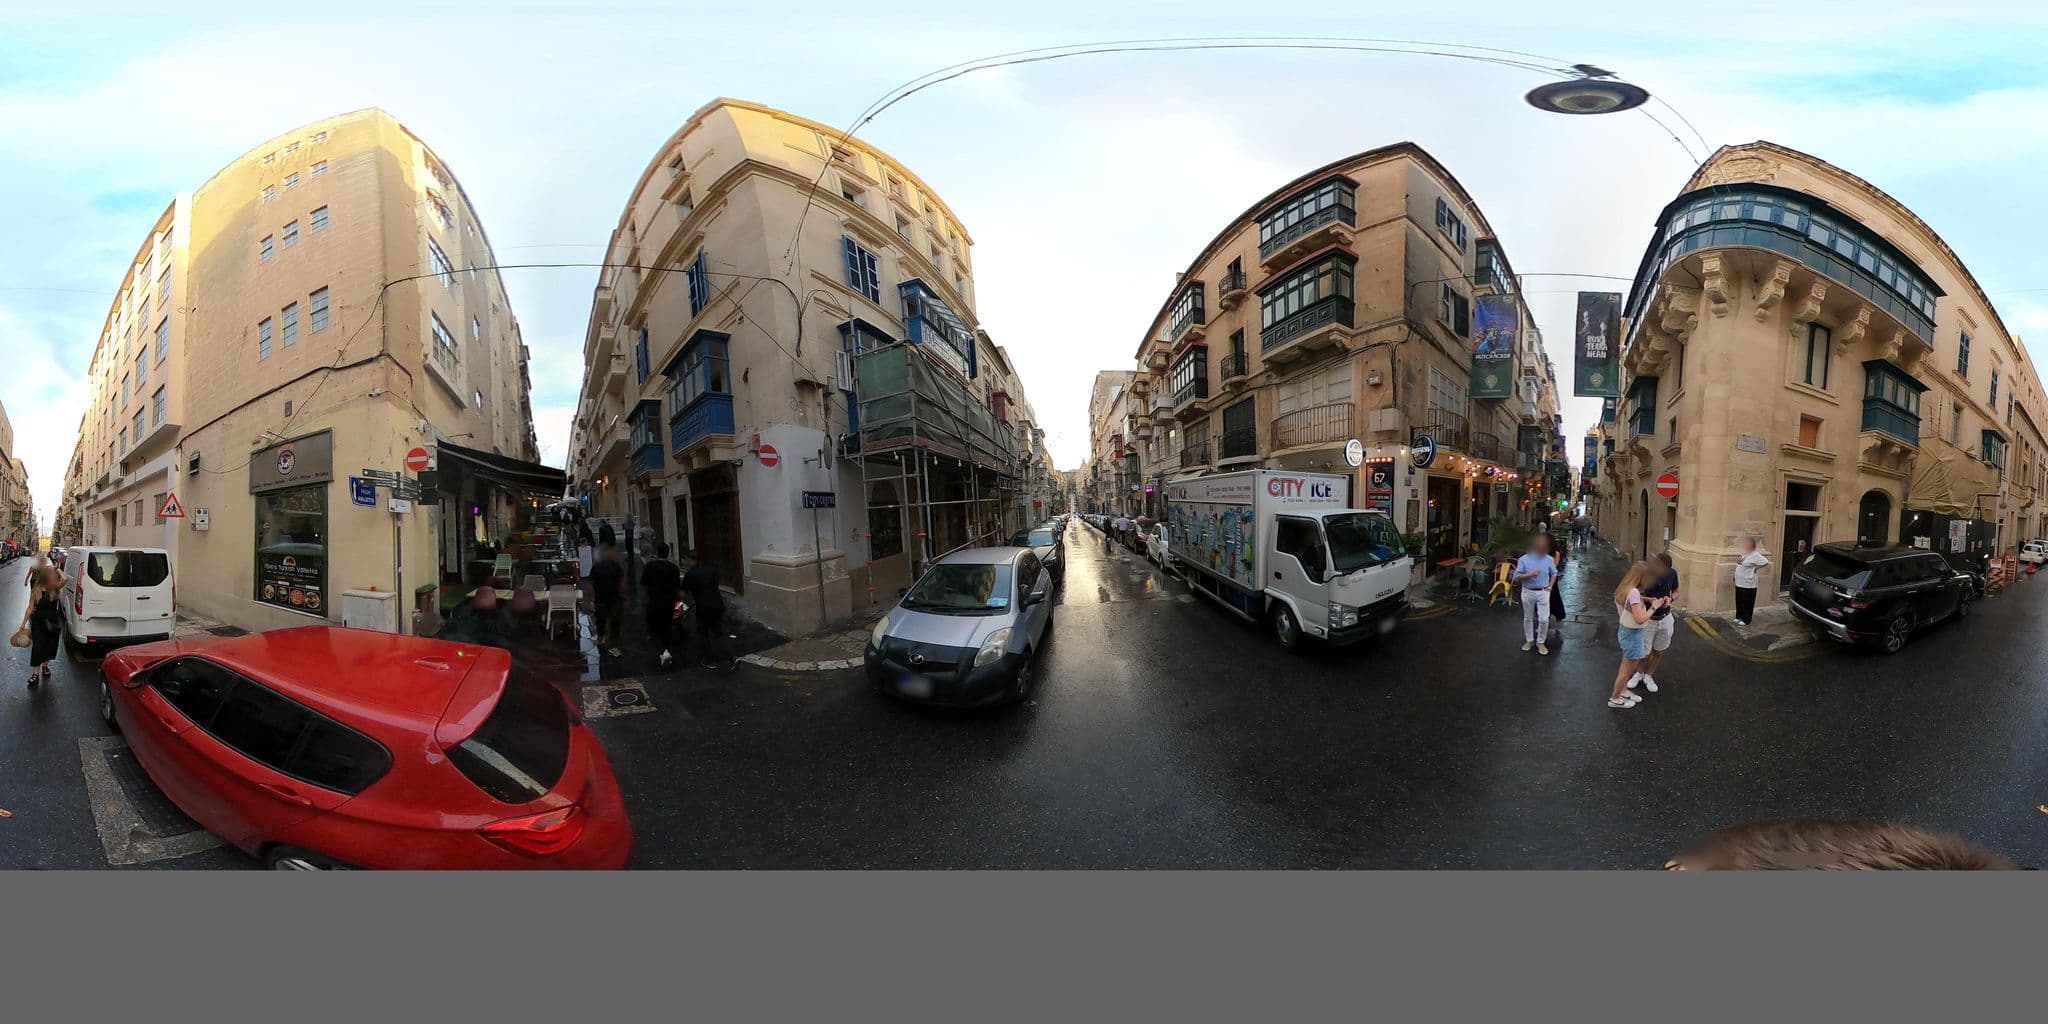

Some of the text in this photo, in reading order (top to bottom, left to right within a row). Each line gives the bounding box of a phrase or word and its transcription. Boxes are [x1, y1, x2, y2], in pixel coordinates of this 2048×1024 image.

[1586, 350, 1607, 359] NEAN
[1374, 472, 1386, 483] 67
[1169, 486, 1179, 500] CITY
[1267, 477, 1333, 498] CITY ICE
[809, 495, 819, 504] CITY
[1375, 588, 1394, 599] ISUZU
